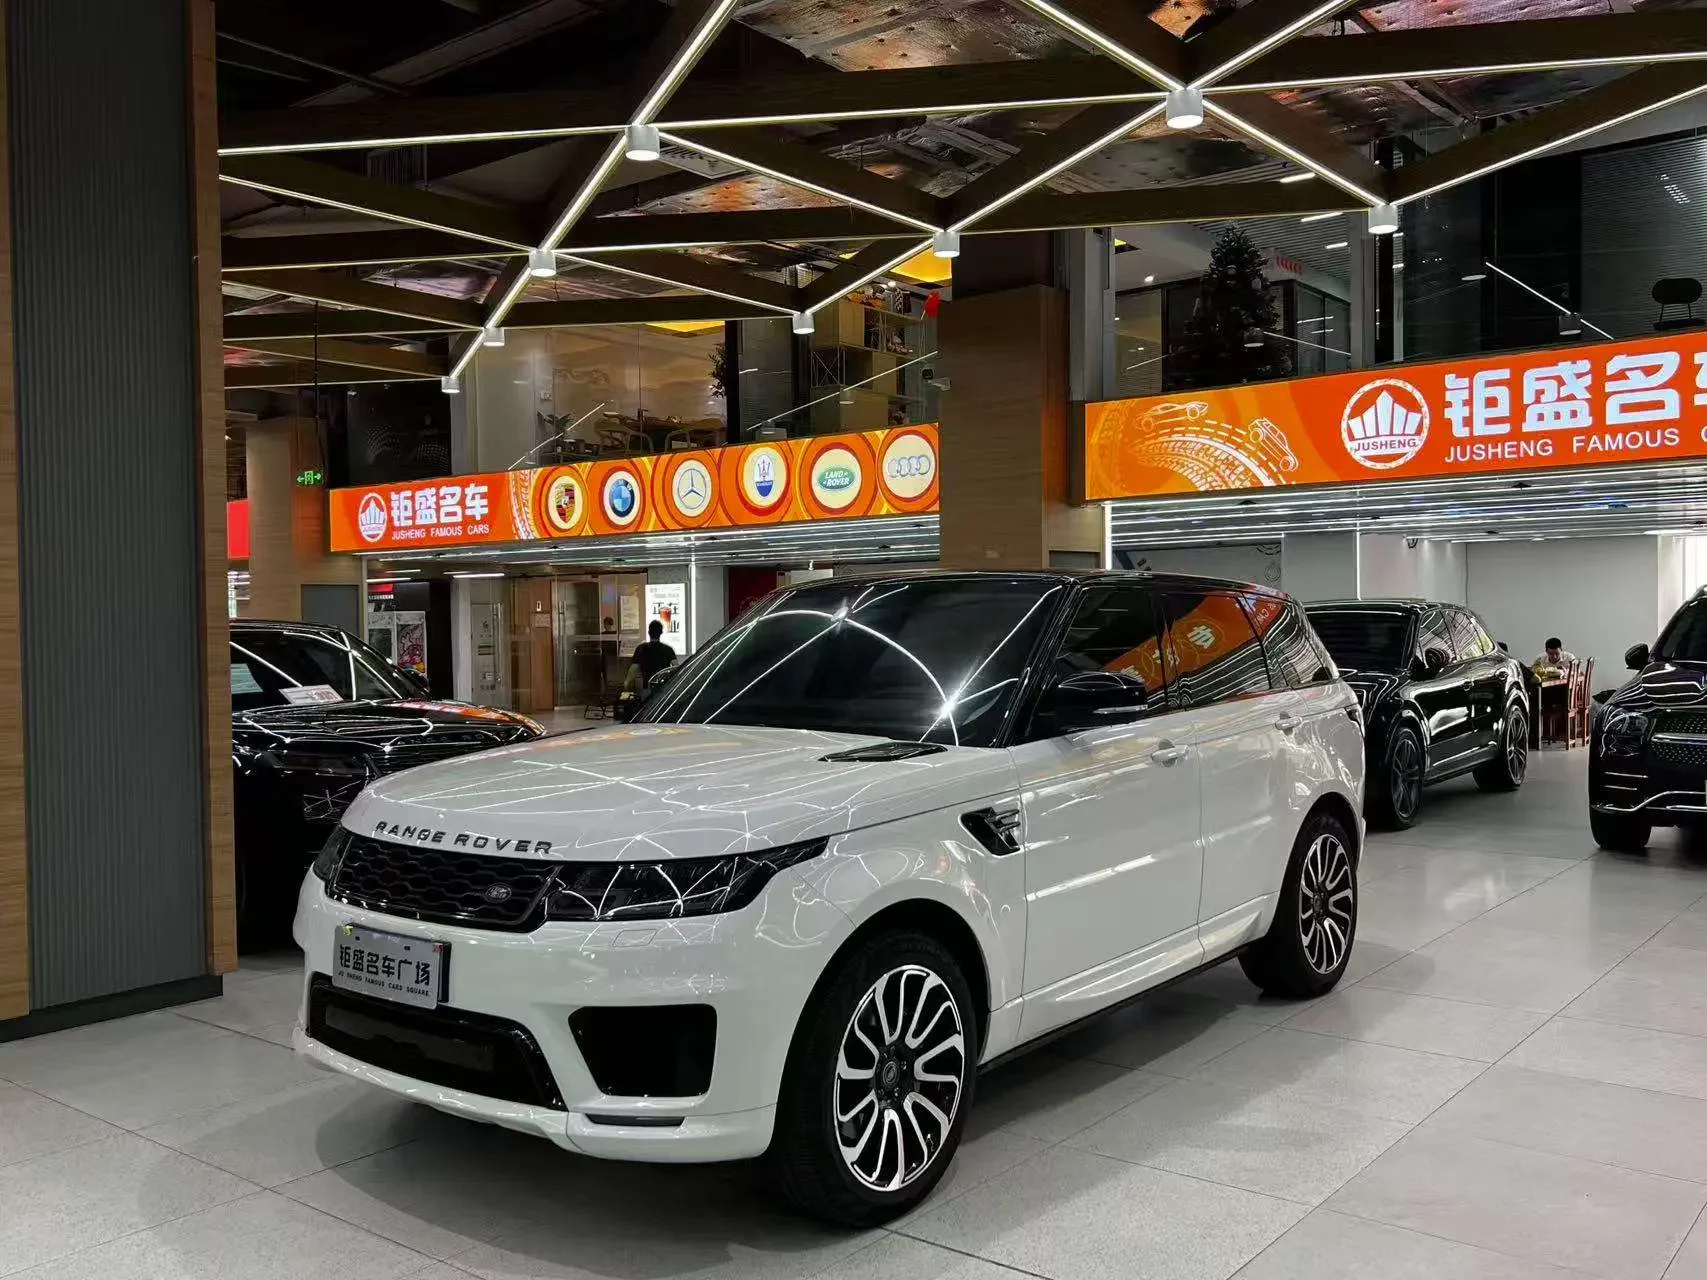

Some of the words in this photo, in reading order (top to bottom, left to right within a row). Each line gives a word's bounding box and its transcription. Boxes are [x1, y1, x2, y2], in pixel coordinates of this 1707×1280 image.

[1444, 351, 1707, 437] 钜盛名
[1354, 438, 1418, 452] JUSHENG
[1445, 438, 1553, 463] JUSHENG
[1572, 428, 1680, 453] FAMOUS
[825, 470, 844, 479] LAND
[826, 477, 850, 487] ROVER
[390, 483, 489, 527] 钜盛名车
[391, 528, 426, 541] JUSHENG
[430, 525, 463, 538] FAMOUS
[467, 524, 490, 535] CARS
[375, 821, 446, 843] RANGE
[453, 833, 553, 854] ROVER
[339, 944, 430, 986] 钜盛名车广场
